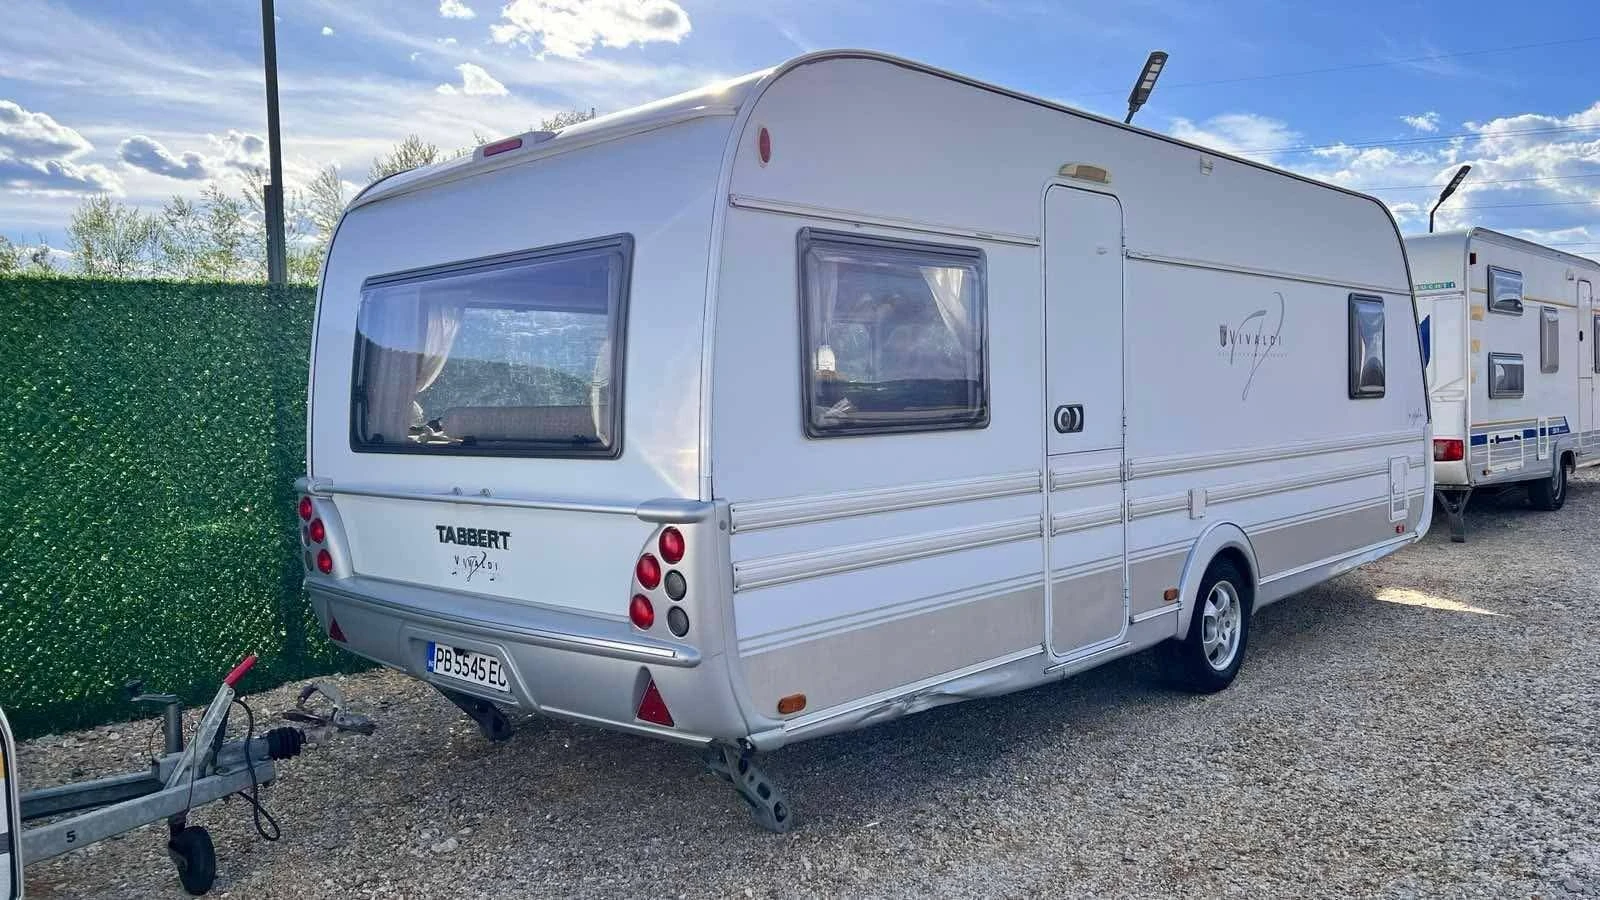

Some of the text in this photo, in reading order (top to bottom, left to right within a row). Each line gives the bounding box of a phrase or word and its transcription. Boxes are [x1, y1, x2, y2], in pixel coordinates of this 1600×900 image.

[1229, 330, 1281, 346] VIVALDI
[435, 525, 511, 550] TABBERT
[454, 554, 498, 571] VIVALDI
[436, 648, 452, 673] PB
[454, 653, 486, 682] 5545
[66, 830, 76, 843] 5
